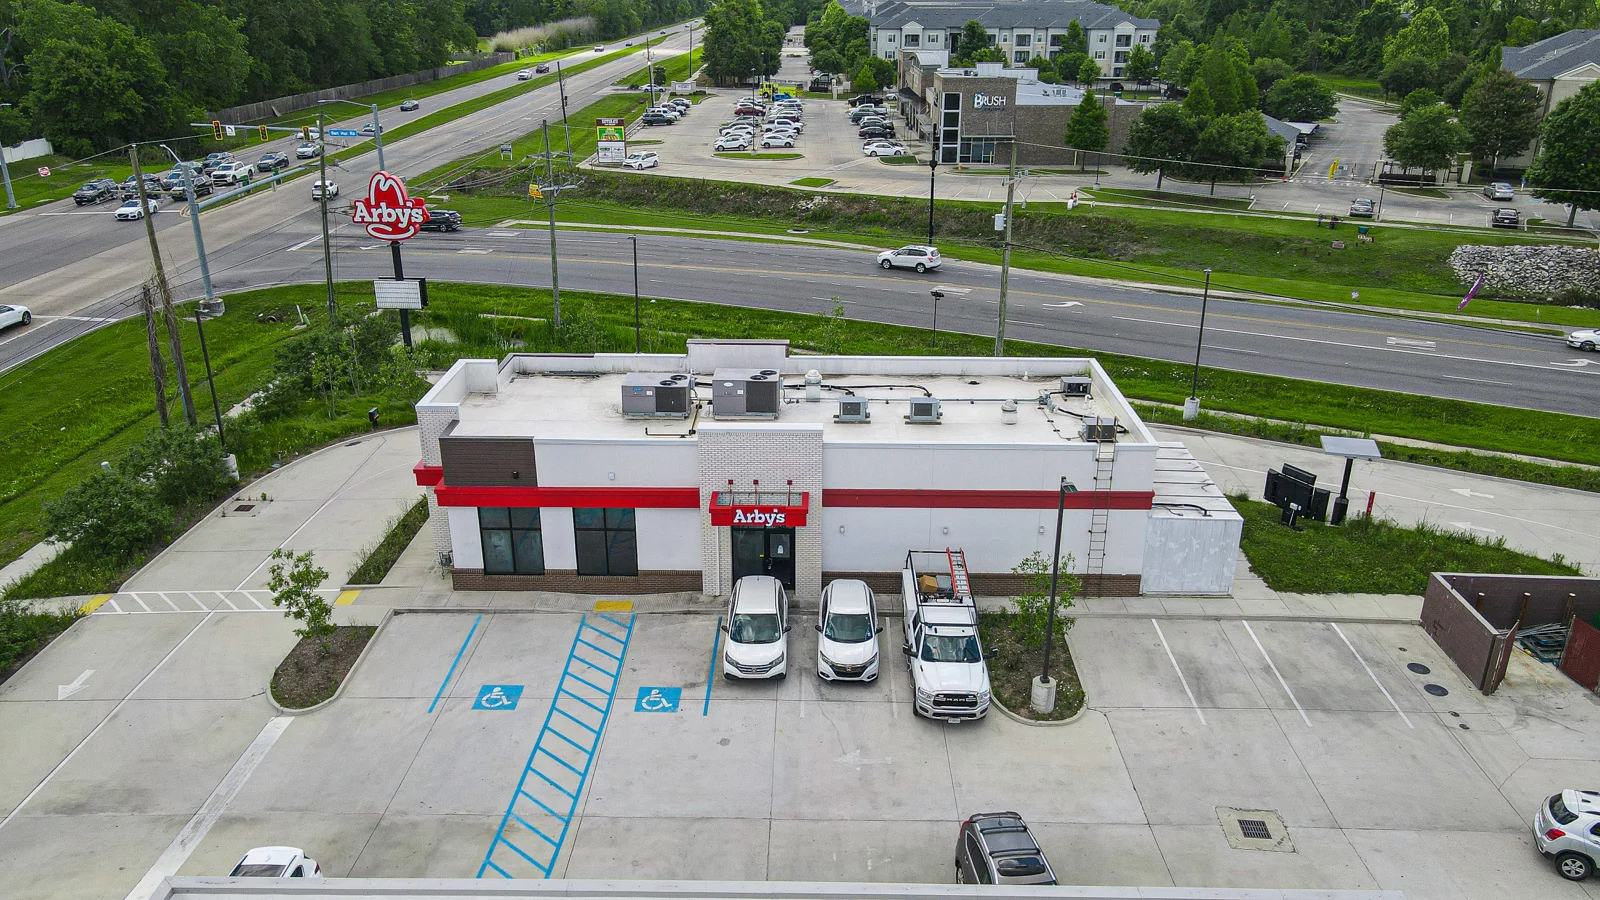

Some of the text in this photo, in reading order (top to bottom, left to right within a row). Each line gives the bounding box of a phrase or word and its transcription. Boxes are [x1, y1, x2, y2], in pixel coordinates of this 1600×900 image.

[974, 93, 1007, 108] BRUSH
[354, 201, 423, 228] Arby's
[733, 508, 786, 527] Arby's
